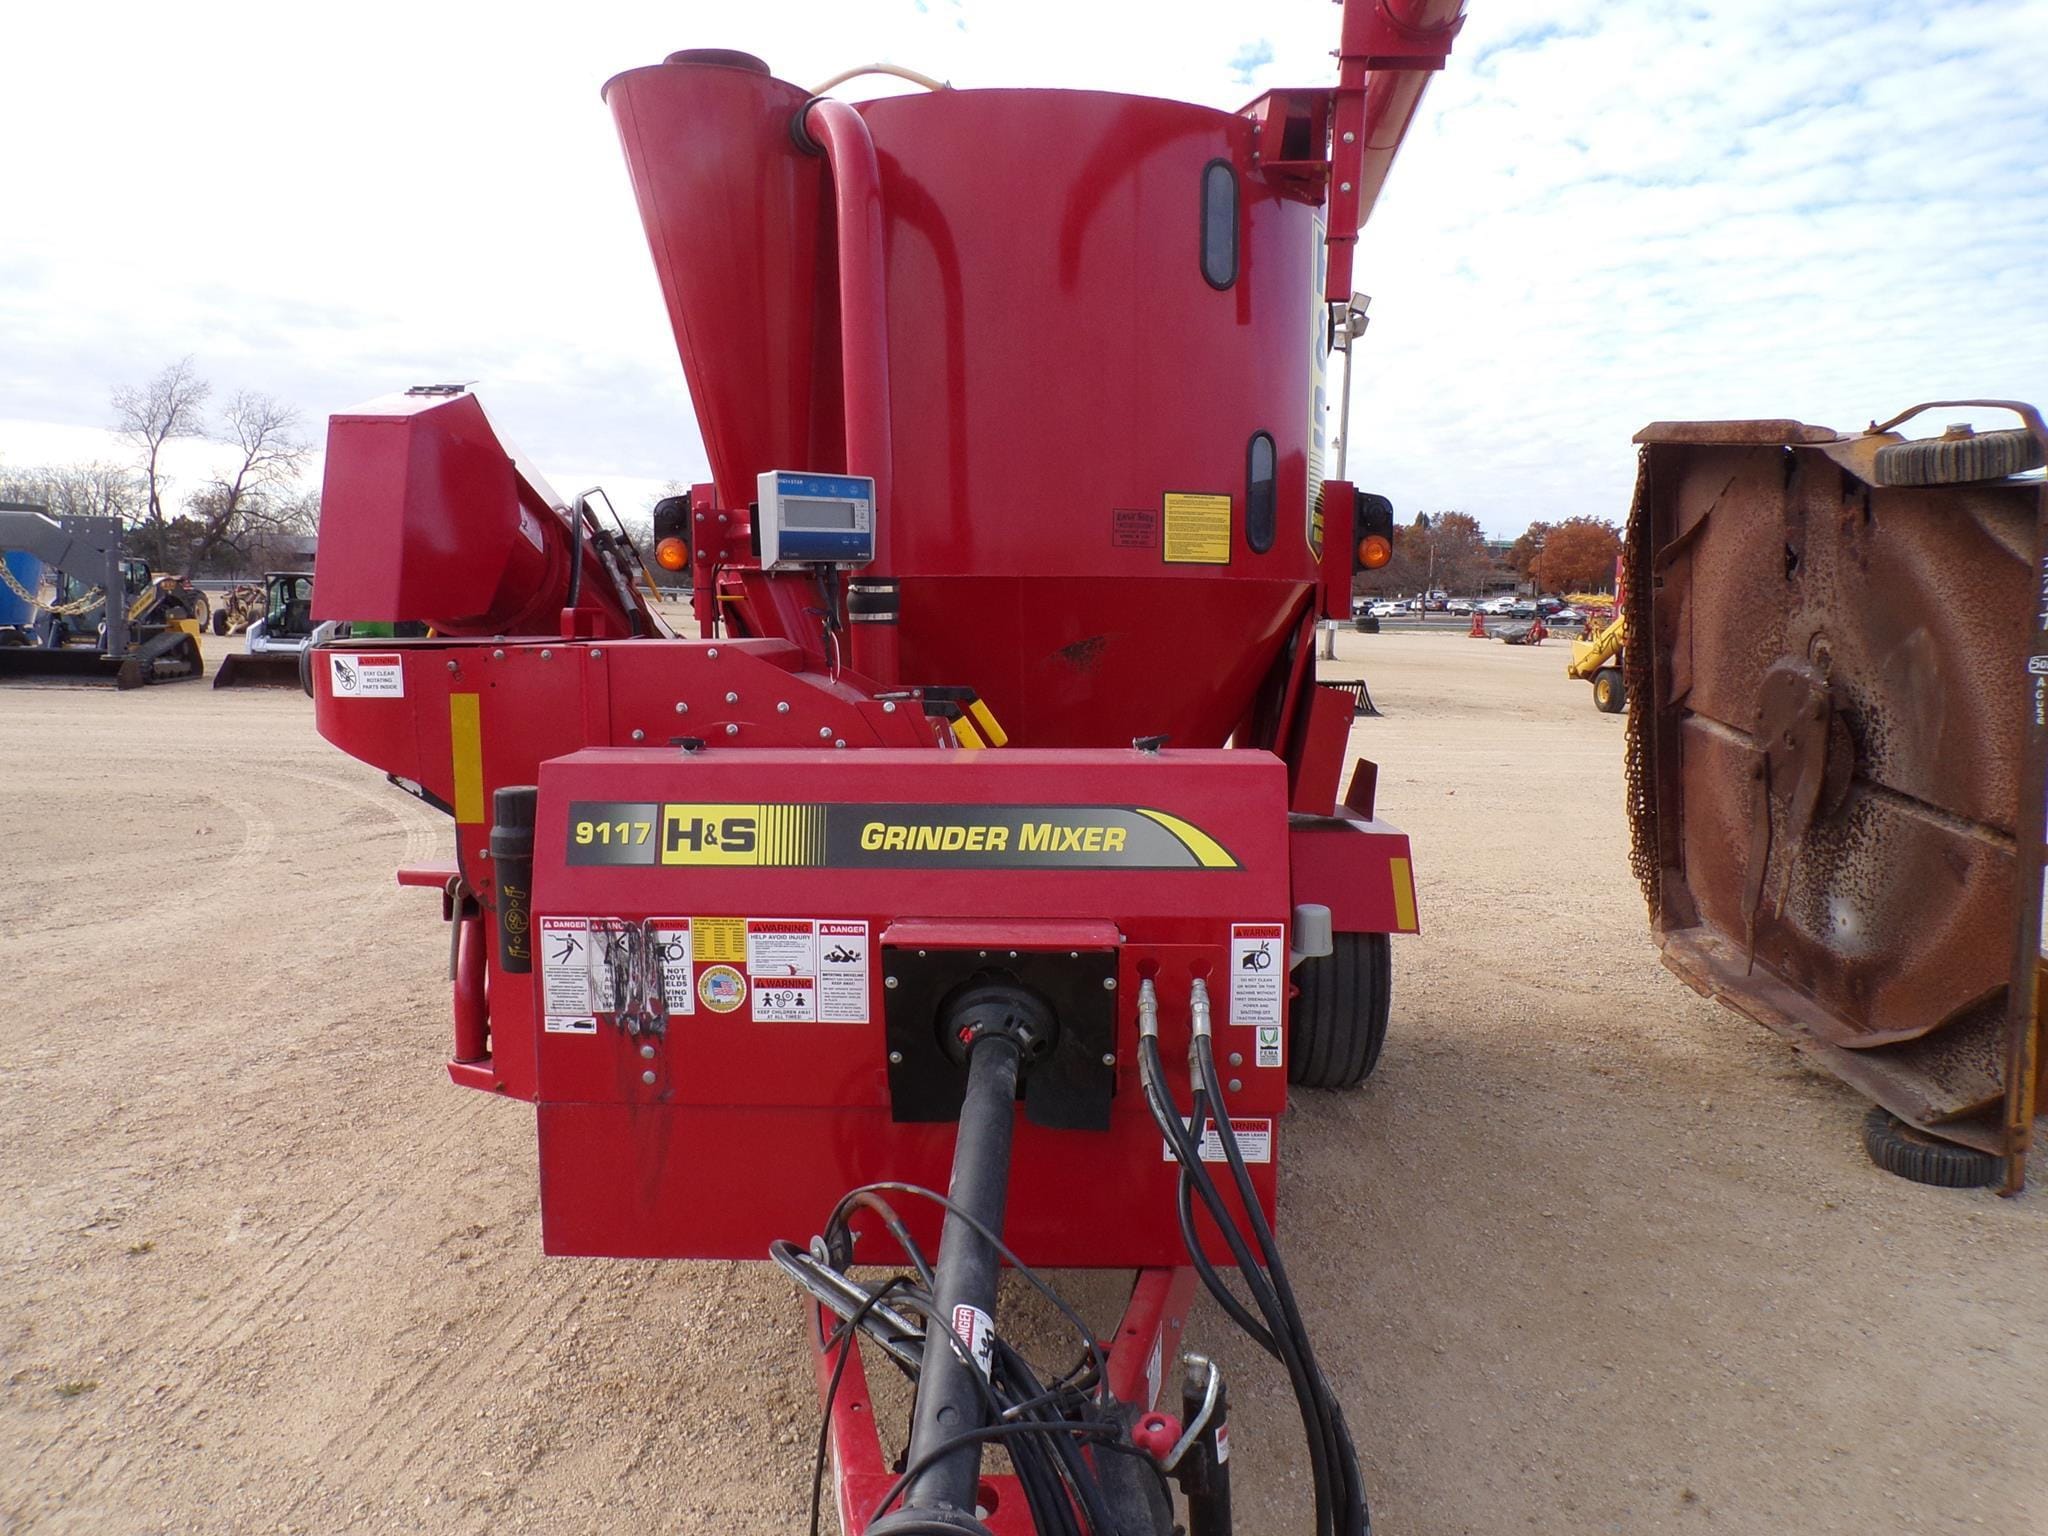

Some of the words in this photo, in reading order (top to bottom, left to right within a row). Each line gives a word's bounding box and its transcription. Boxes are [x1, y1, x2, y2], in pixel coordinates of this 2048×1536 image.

[575, 821, 651, 845] 9117
[666, 818, 756, 852] H&S
[860, 822, 1009, 851] GRINDER
[1018, 823, 1127, 851] MIXER
[761, 923, 809, 932] WARNING
[830, 925, 865, 933] DANGER
[1243, 928, 1280, 937] WARNING
[769, 979, 811, 988] WARNING
[958, 1309, 972, 1347] ANGER
